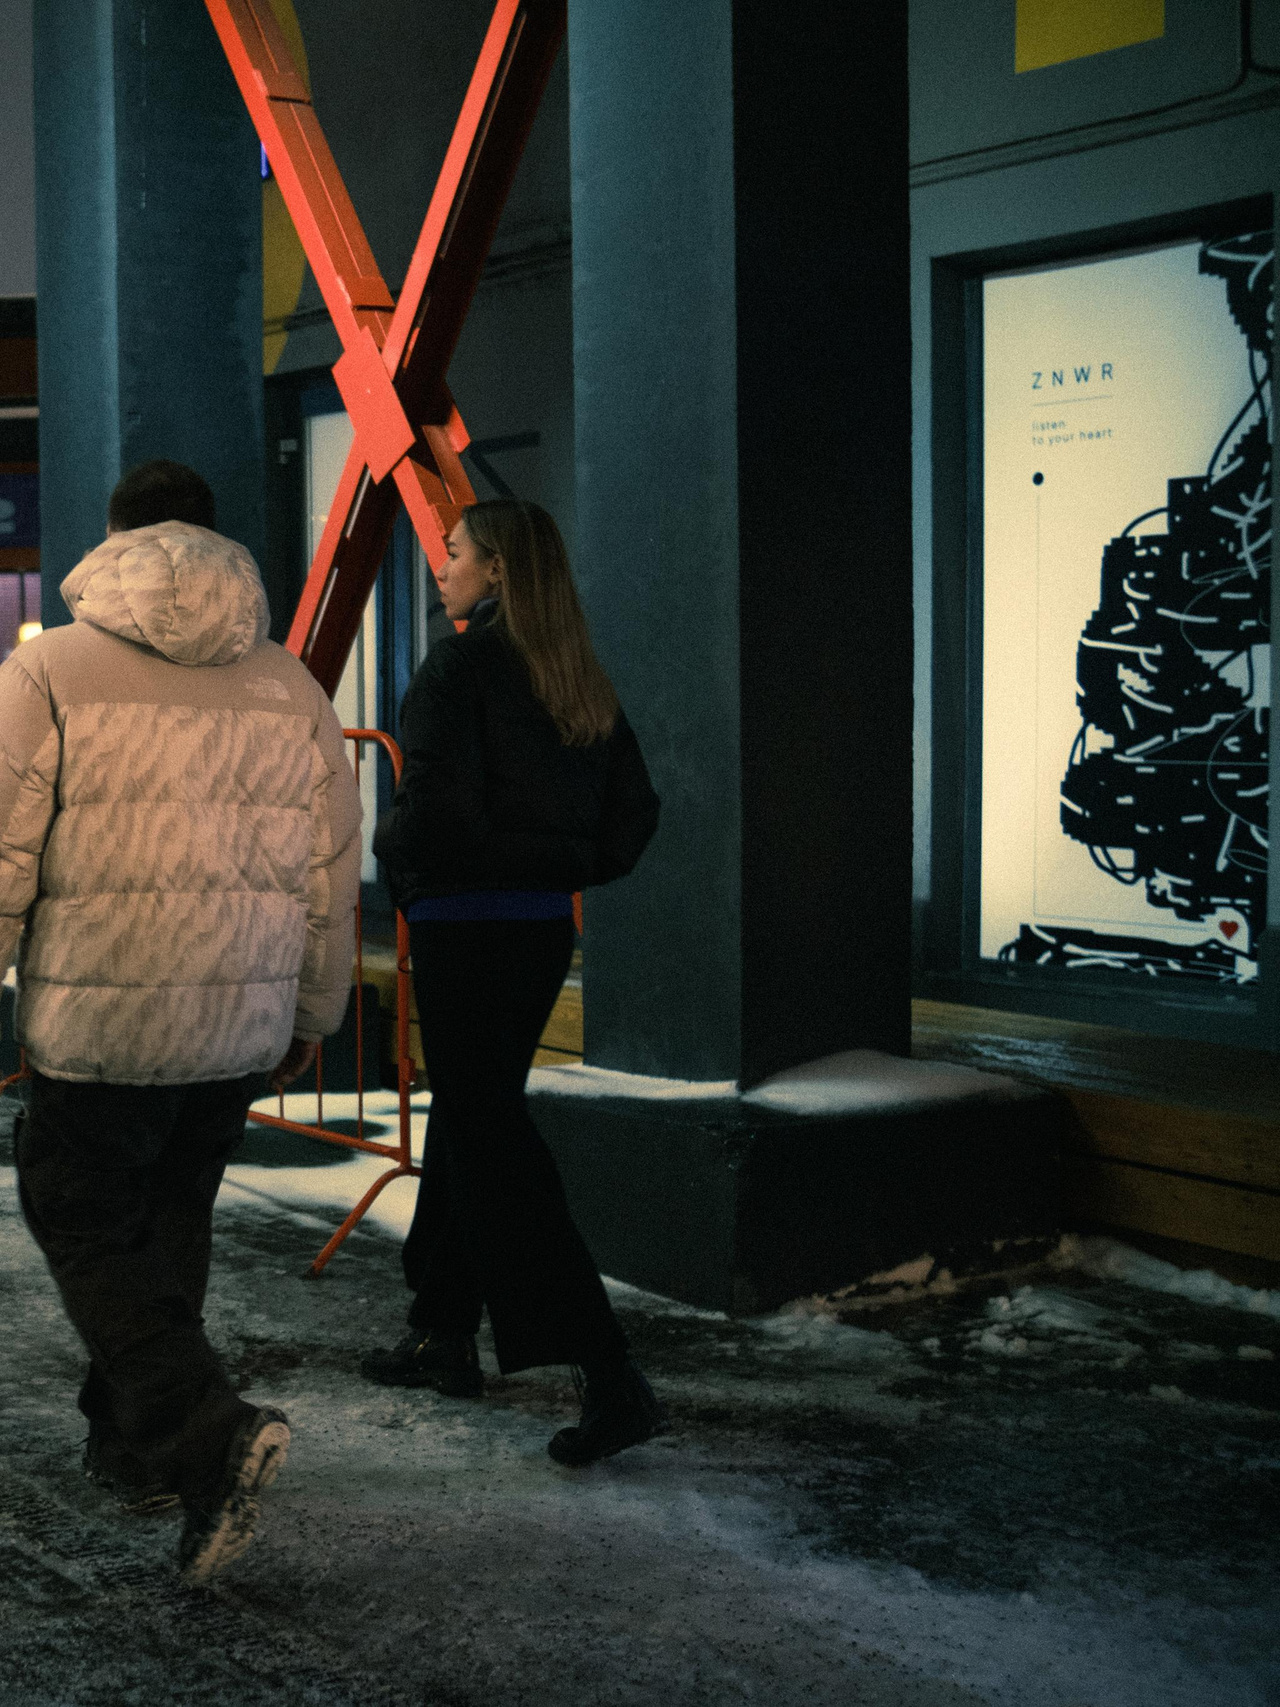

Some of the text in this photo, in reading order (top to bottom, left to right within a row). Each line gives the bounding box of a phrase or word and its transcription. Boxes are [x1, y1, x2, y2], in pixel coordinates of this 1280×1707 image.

[1031, 420, 1066, 431] listen
[1031, 428, 1113, 446] to your heart
